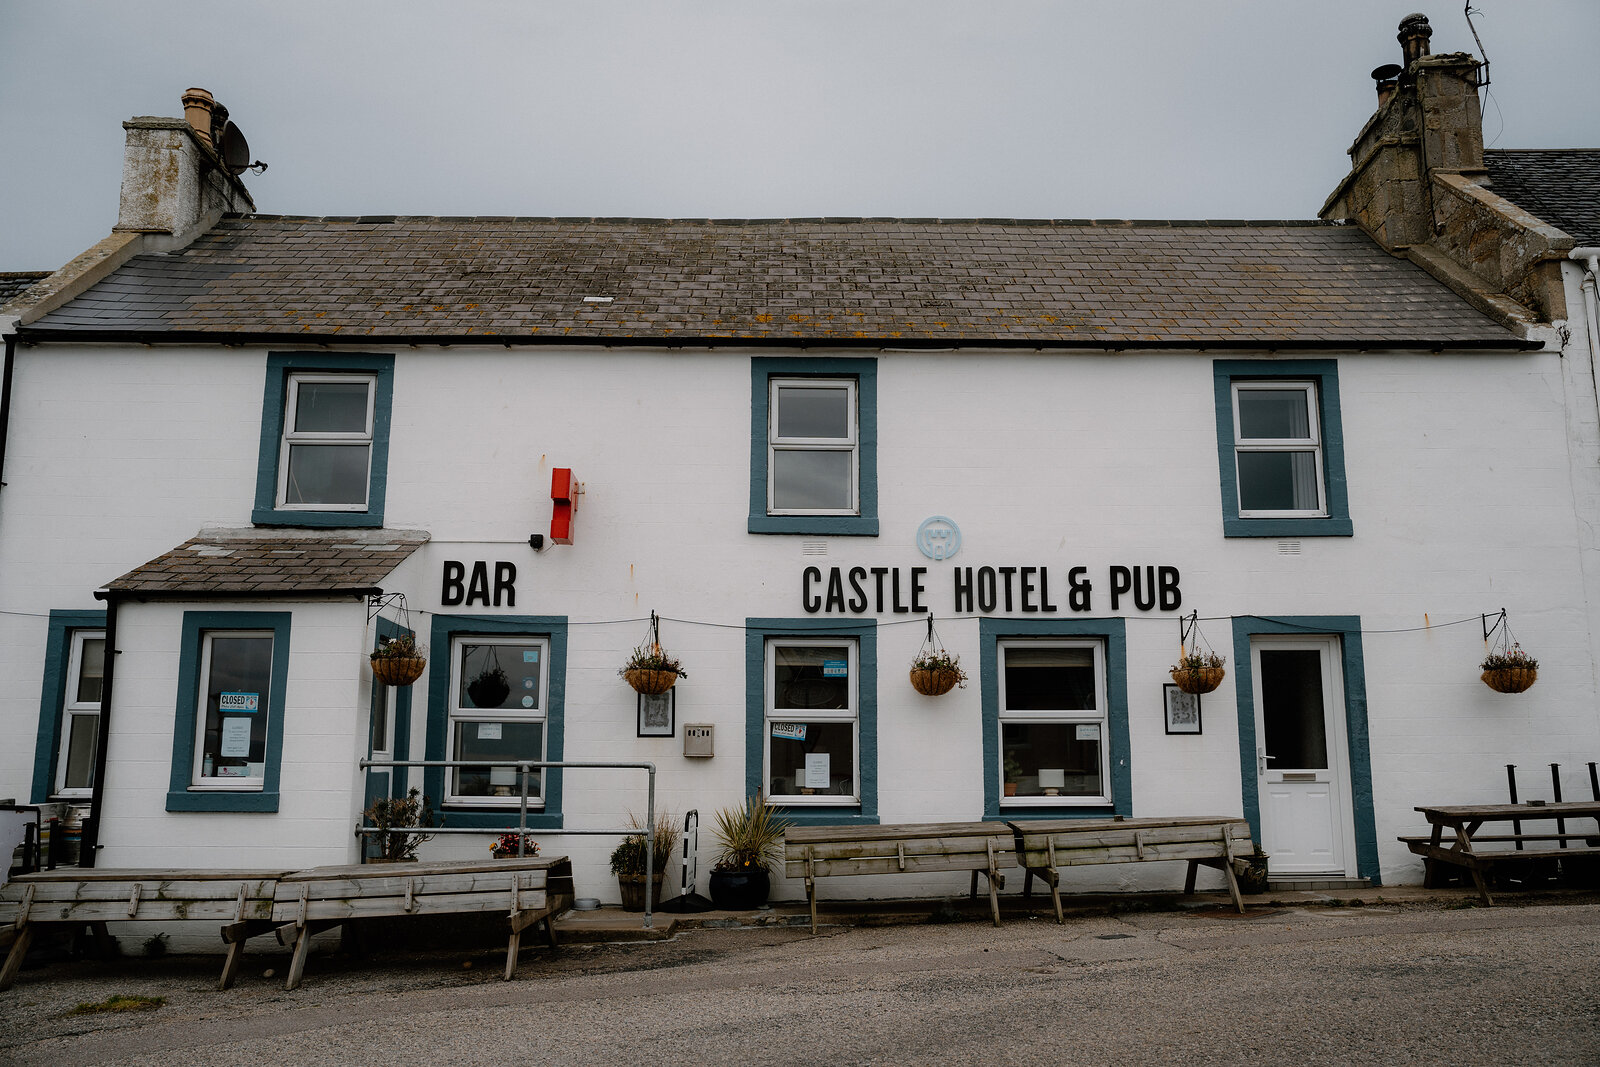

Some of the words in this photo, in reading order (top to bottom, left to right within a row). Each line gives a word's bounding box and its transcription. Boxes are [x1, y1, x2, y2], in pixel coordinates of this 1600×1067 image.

[441, 561, 516, 607] BAR
[802, 566, 928, 614] CASTLE
[954, 566, 1057, 613] HOTEL
[1068, 566, 1093, 612] &
[1109, 565, 1182, 612] PUB
[222, 695, 245, 704] CLOSED
[774, 723, 794, 732] CLOSED
